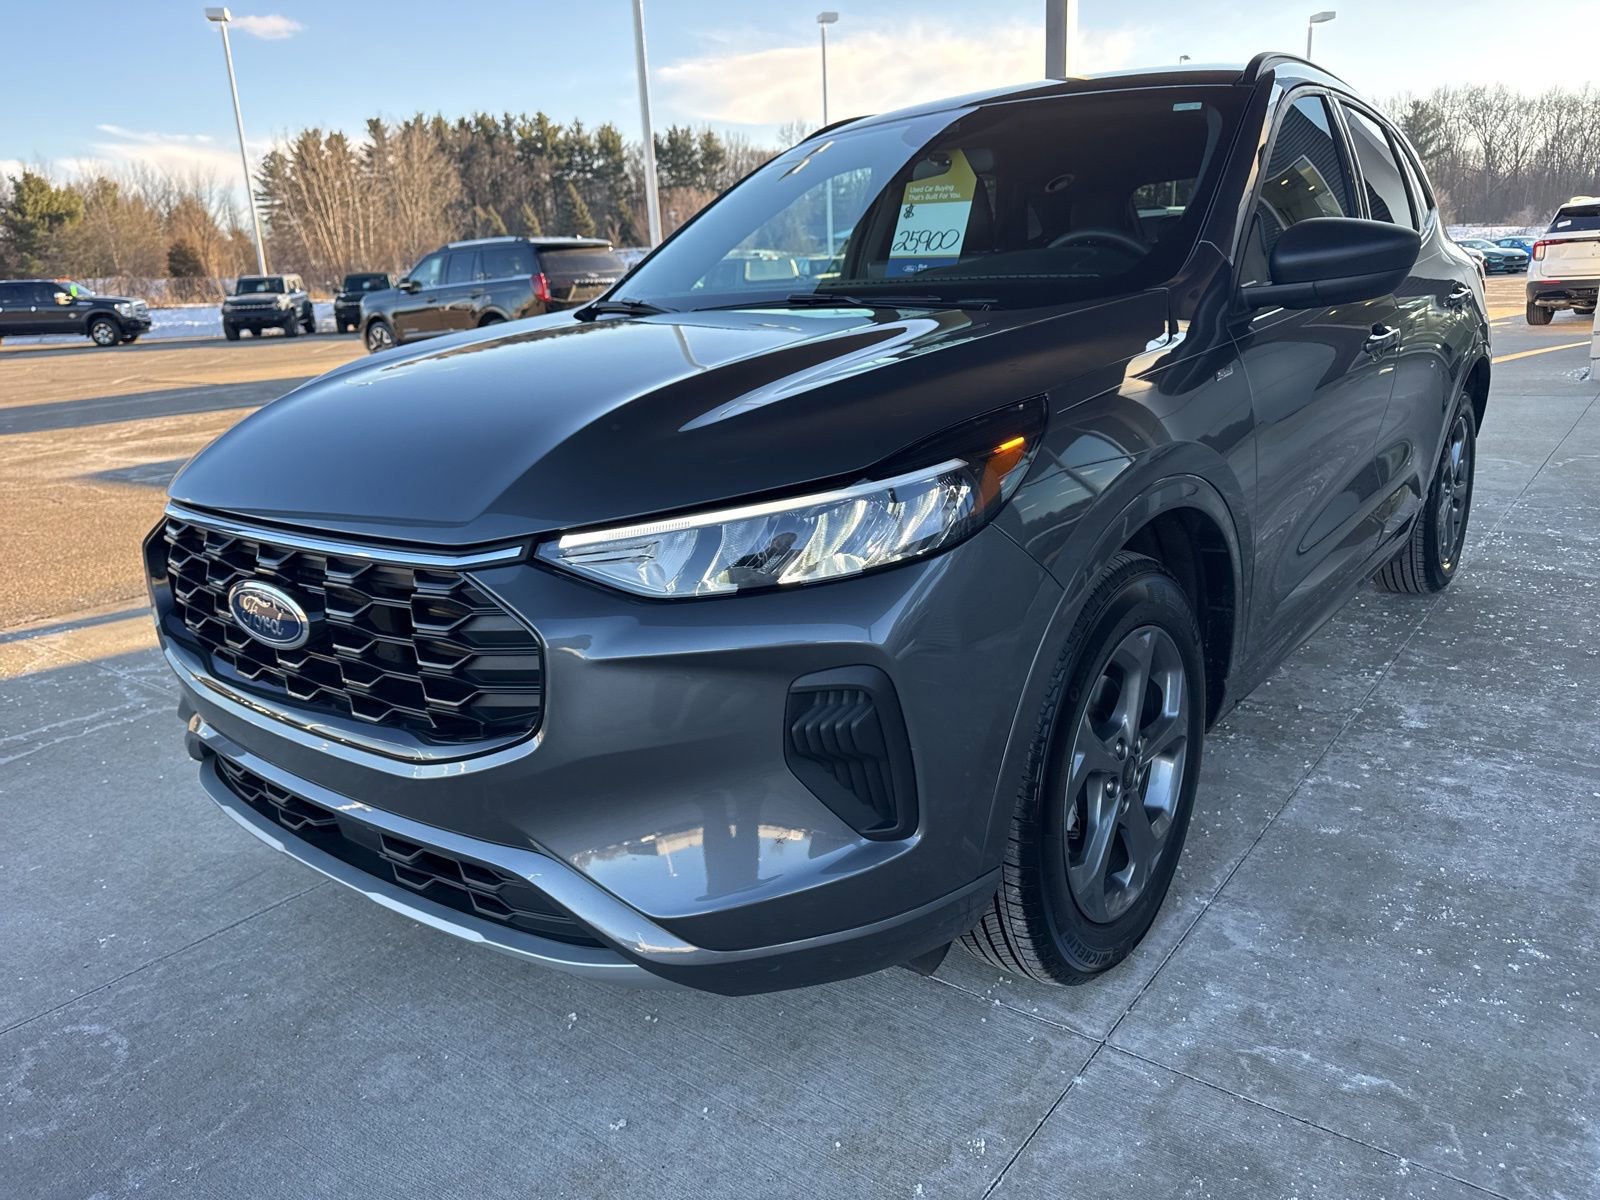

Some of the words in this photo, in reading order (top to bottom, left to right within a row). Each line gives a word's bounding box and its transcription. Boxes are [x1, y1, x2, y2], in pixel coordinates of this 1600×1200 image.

[910, 185, 924, 193] Used
[924, 184, 934, 192] Car
[935, 183, 955, 193] Buying
[240, 594, 286, 637] Ford
[1063, 934, 1112, 966] MICHELIN
